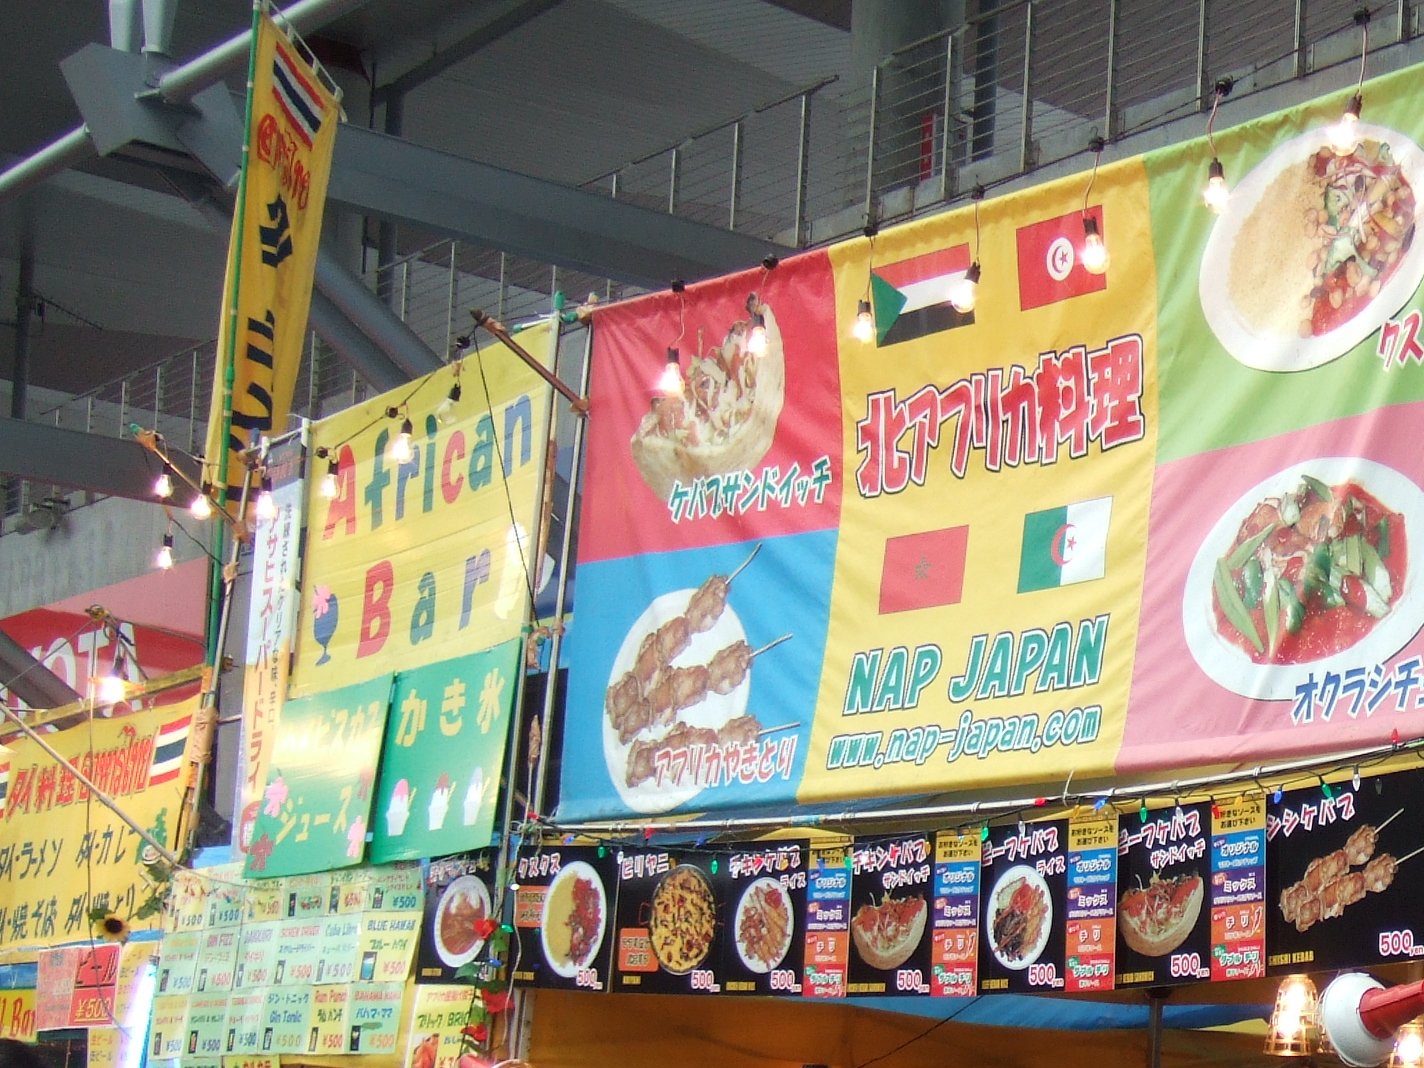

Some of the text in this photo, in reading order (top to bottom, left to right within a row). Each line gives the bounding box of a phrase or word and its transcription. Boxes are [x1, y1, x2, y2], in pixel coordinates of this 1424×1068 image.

[855, 332, 1147, 498] 北アフリカ料理
[322, 394, 532, 541] African
[668, 454, 833, 521] ケバブサンドイッチ
[356, 547, 492, 660] Bar
[842, 613, 1112, 717] NAP JAPAN
[395, 668, 505, 747] かき氷
[826, 704, 1102, 771] www.nap-japan.com
[654, 734, 800, 790] アフリカやきとり
[276, 784, 352, 845] ジュース
[1118, 809, 1202, 856] ビーフケバブ
[1215, 806, 1262, 819] 好きなソースを
[1266, 792, 1356, 842] シシケバブ
[518, 852, 562, 879] クスクス
[621, 852, 670, 880] ビリヤニ
[852, 838, 926, 876] チキンケバブ
[982, 826, 1059, 868] ビーフケバブ
[1035, 855, 1066, 878] ライス
[1150, 837, 1206, 870] サンドイッチ
[1220, 840, 1259, 857] オリジナル
[779, 871, 808, 890] ライス
[882, 865, 930, 889] サンドイッチ
[1223, 878, 1257, 893] ミックス
[393, 896, 417, 908] ¥500
